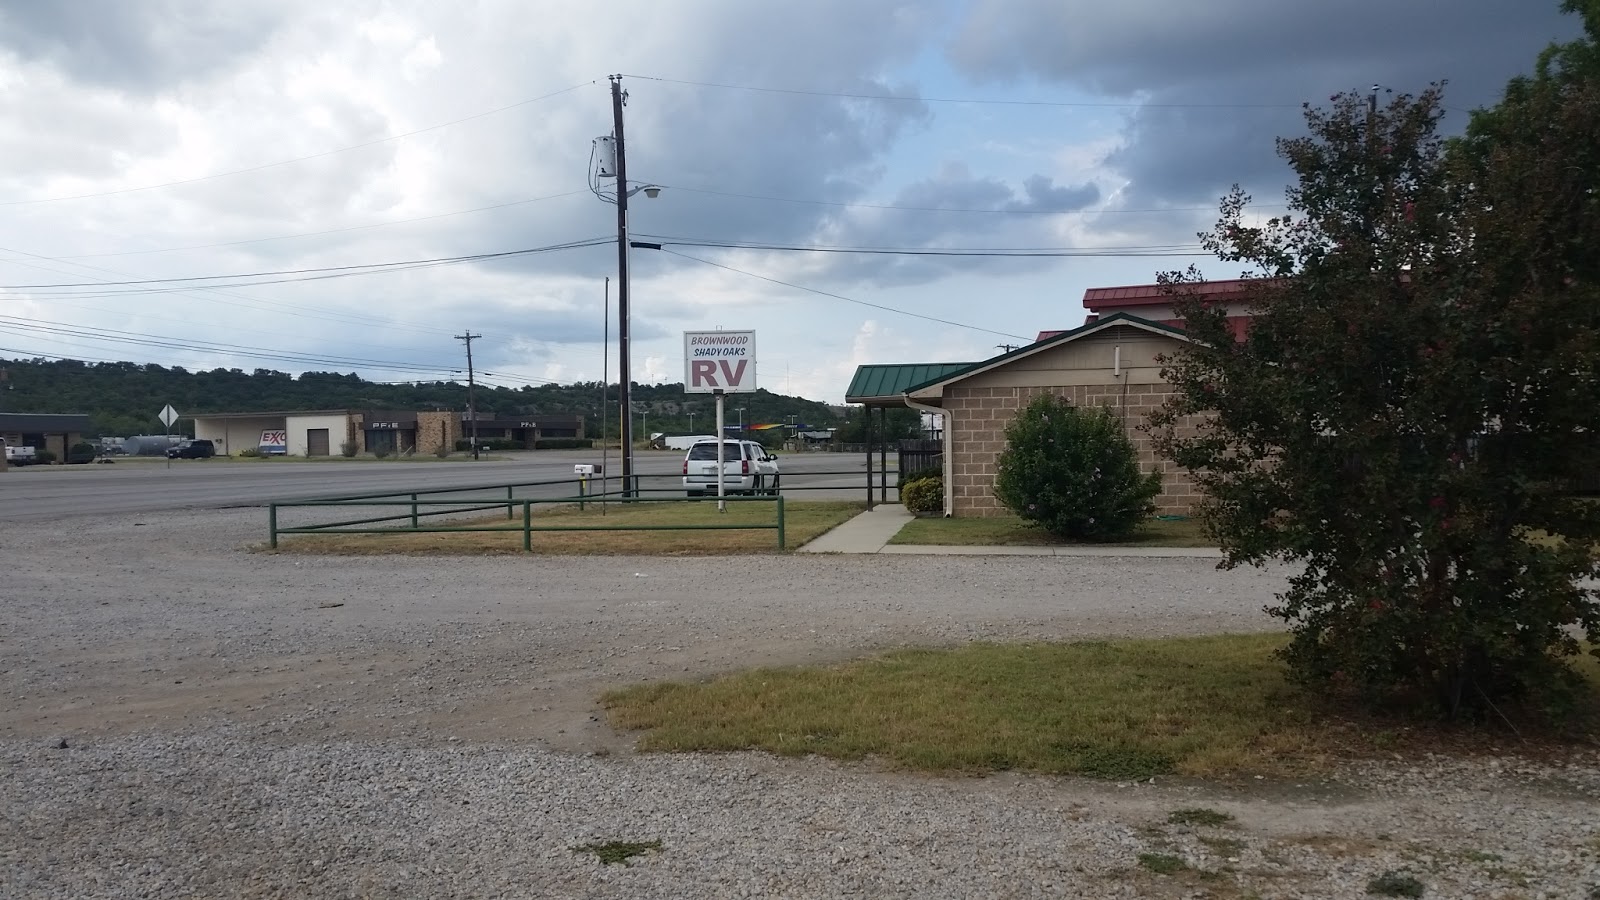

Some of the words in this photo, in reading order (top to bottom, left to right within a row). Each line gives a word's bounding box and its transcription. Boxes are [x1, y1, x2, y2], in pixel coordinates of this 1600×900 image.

[691, 336, 748, 345] BROWNWOOD
[694, 348, 722, 356] SHADY
[722, 347, 746, 356] OAKS
[692, 360, 748, 387] RV
